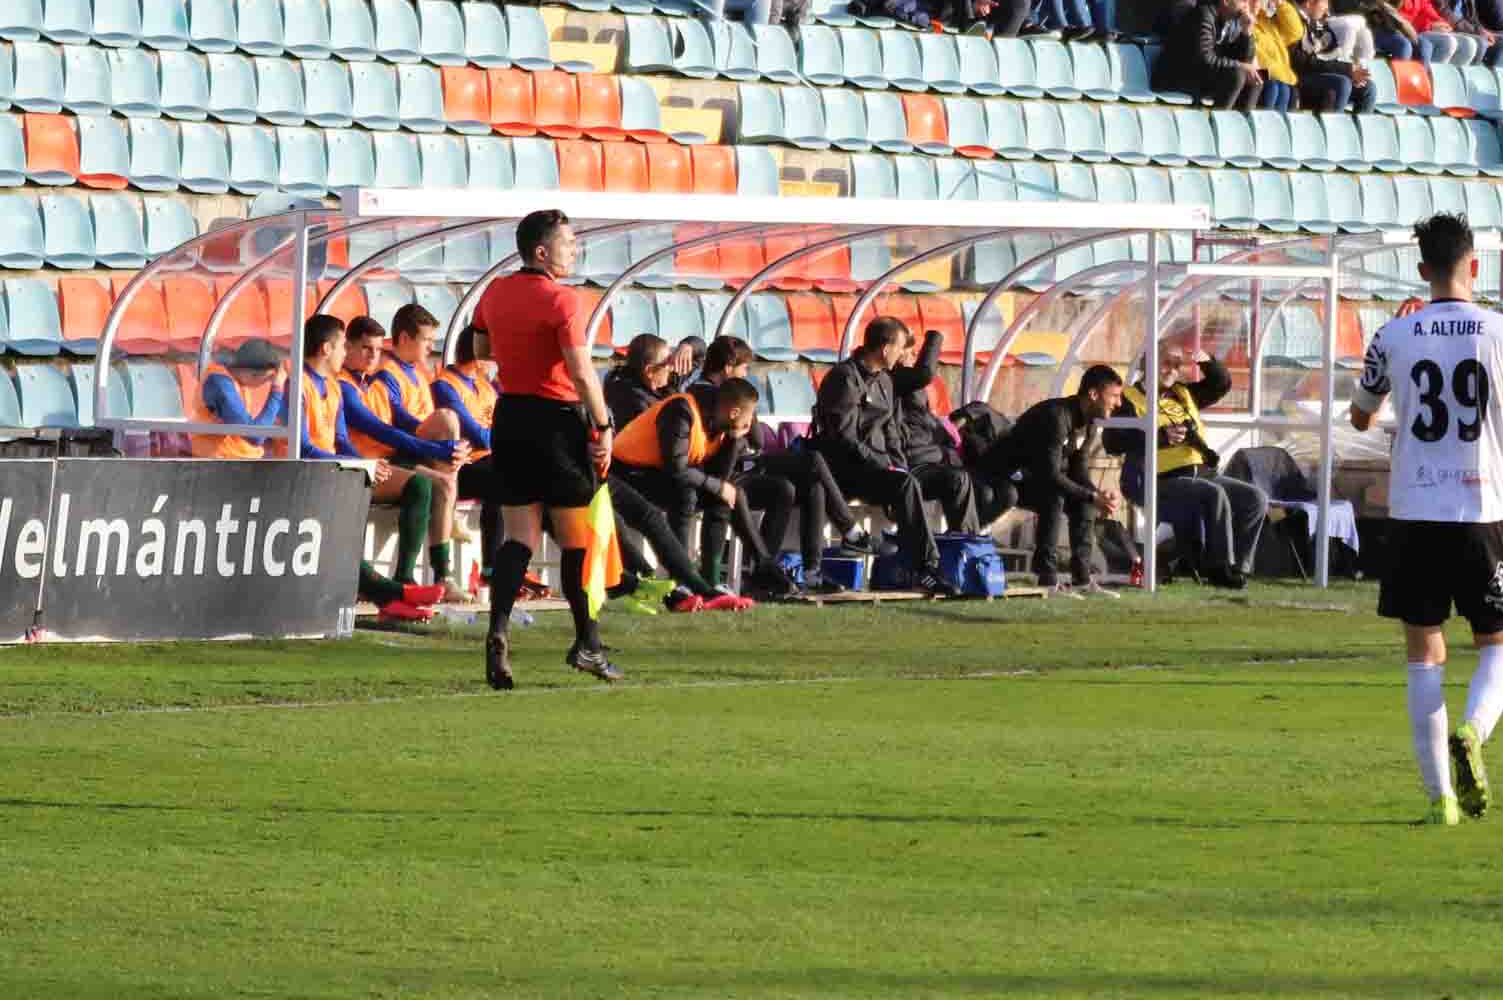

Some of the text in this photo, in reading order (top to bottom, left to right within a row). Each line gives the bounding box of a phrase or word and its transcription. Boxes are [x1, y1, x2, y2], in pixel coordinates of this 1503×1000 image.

[1414, 320, 1486, 336] A. ALTUBE
[1410, 359, 1489, 443] 39
[0, 494, 323, 579] elmántica
